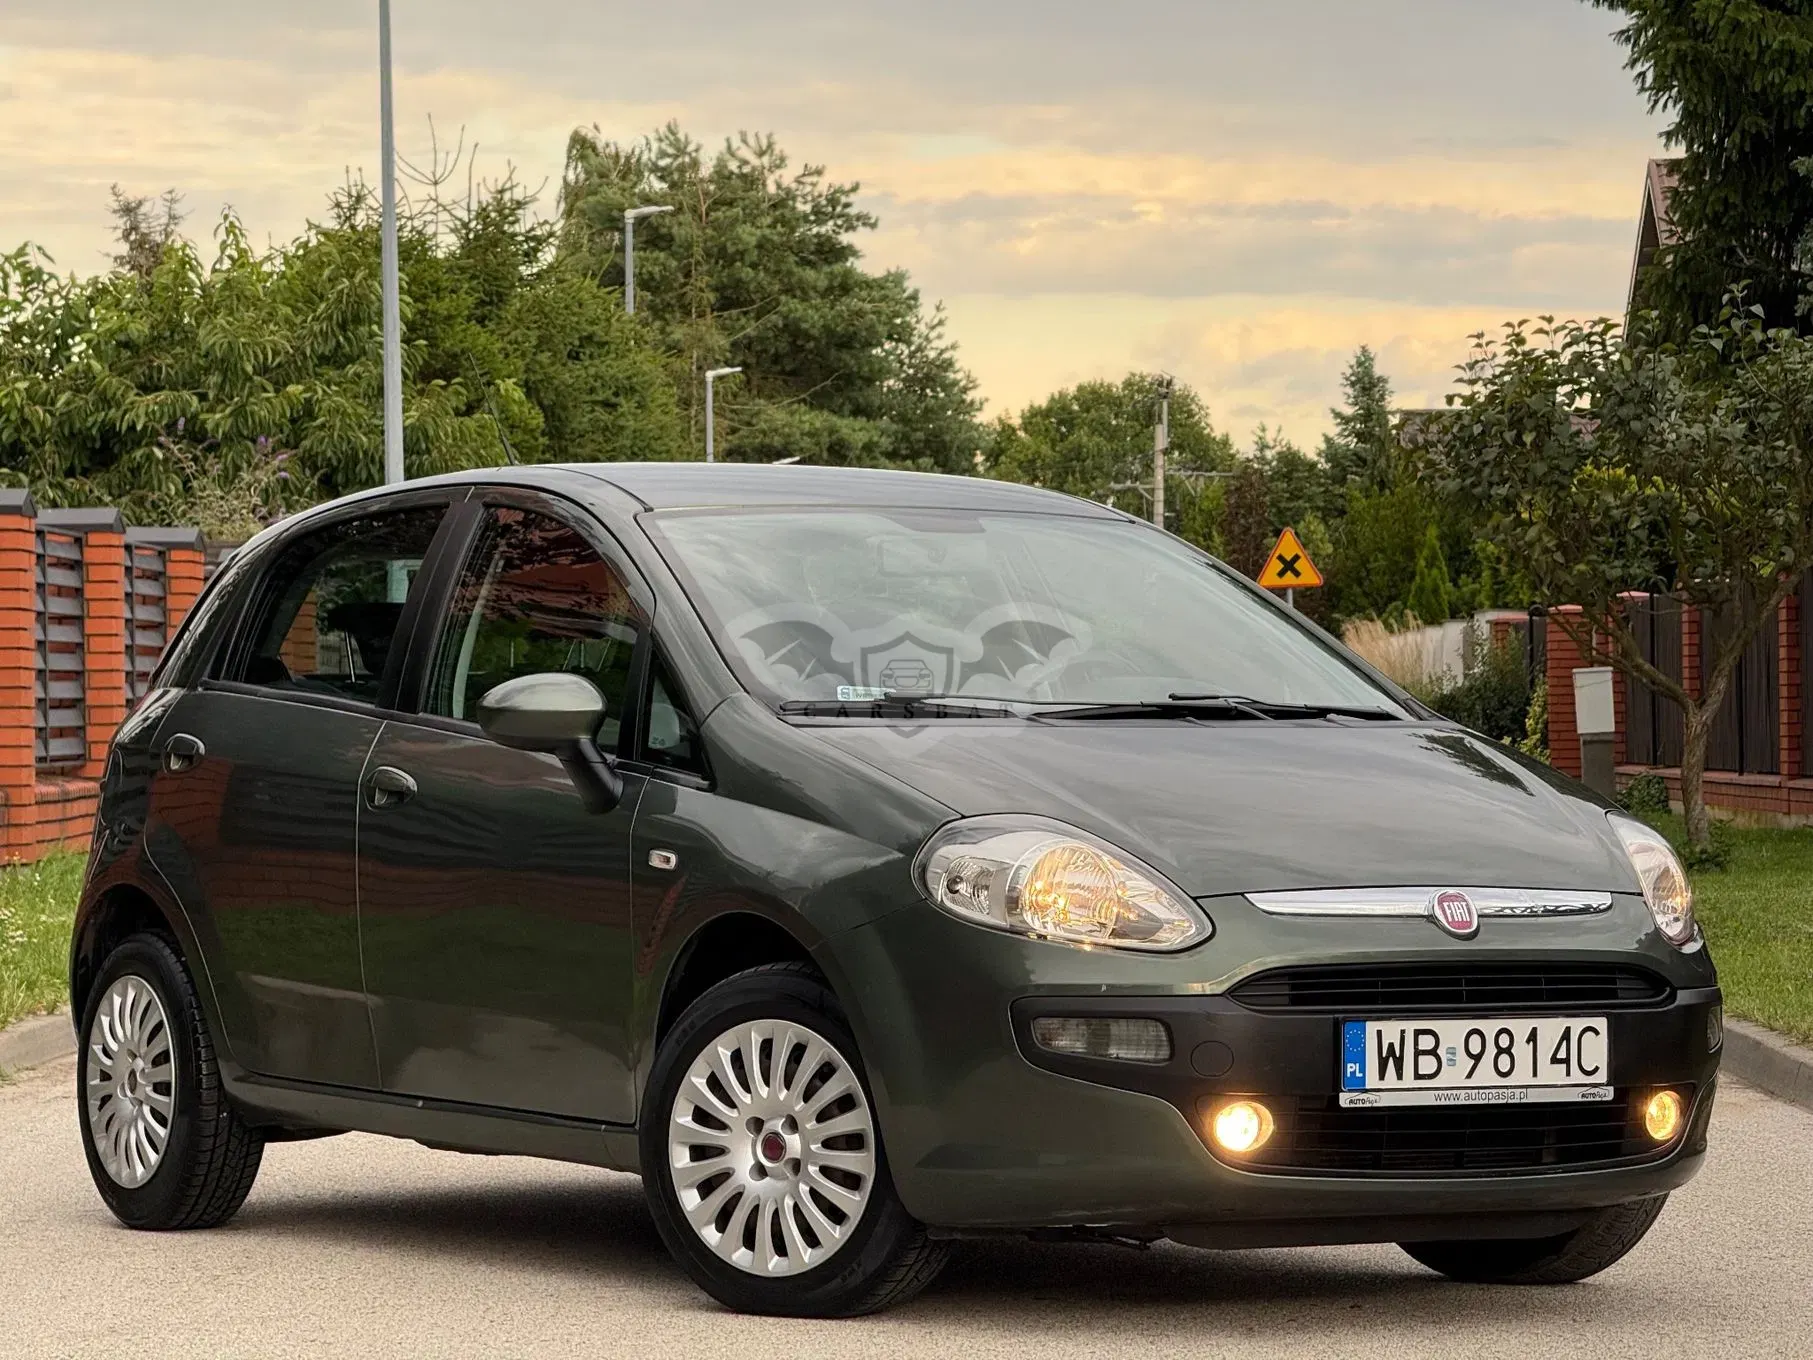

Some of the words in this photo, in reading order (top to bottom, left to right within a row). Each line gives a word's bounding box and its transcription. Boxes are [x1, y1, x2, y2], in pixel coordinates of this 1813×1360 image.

[1443, 901, 1470, 922] FIAT
[1376, 1028, 1443, 1081] WB
[1463, 1025, 1601, 1079] 9814C
[1346, 1063, 1363, 1077] PL
[1433, 1088, 1528, 1103] www.autopasja.pl
